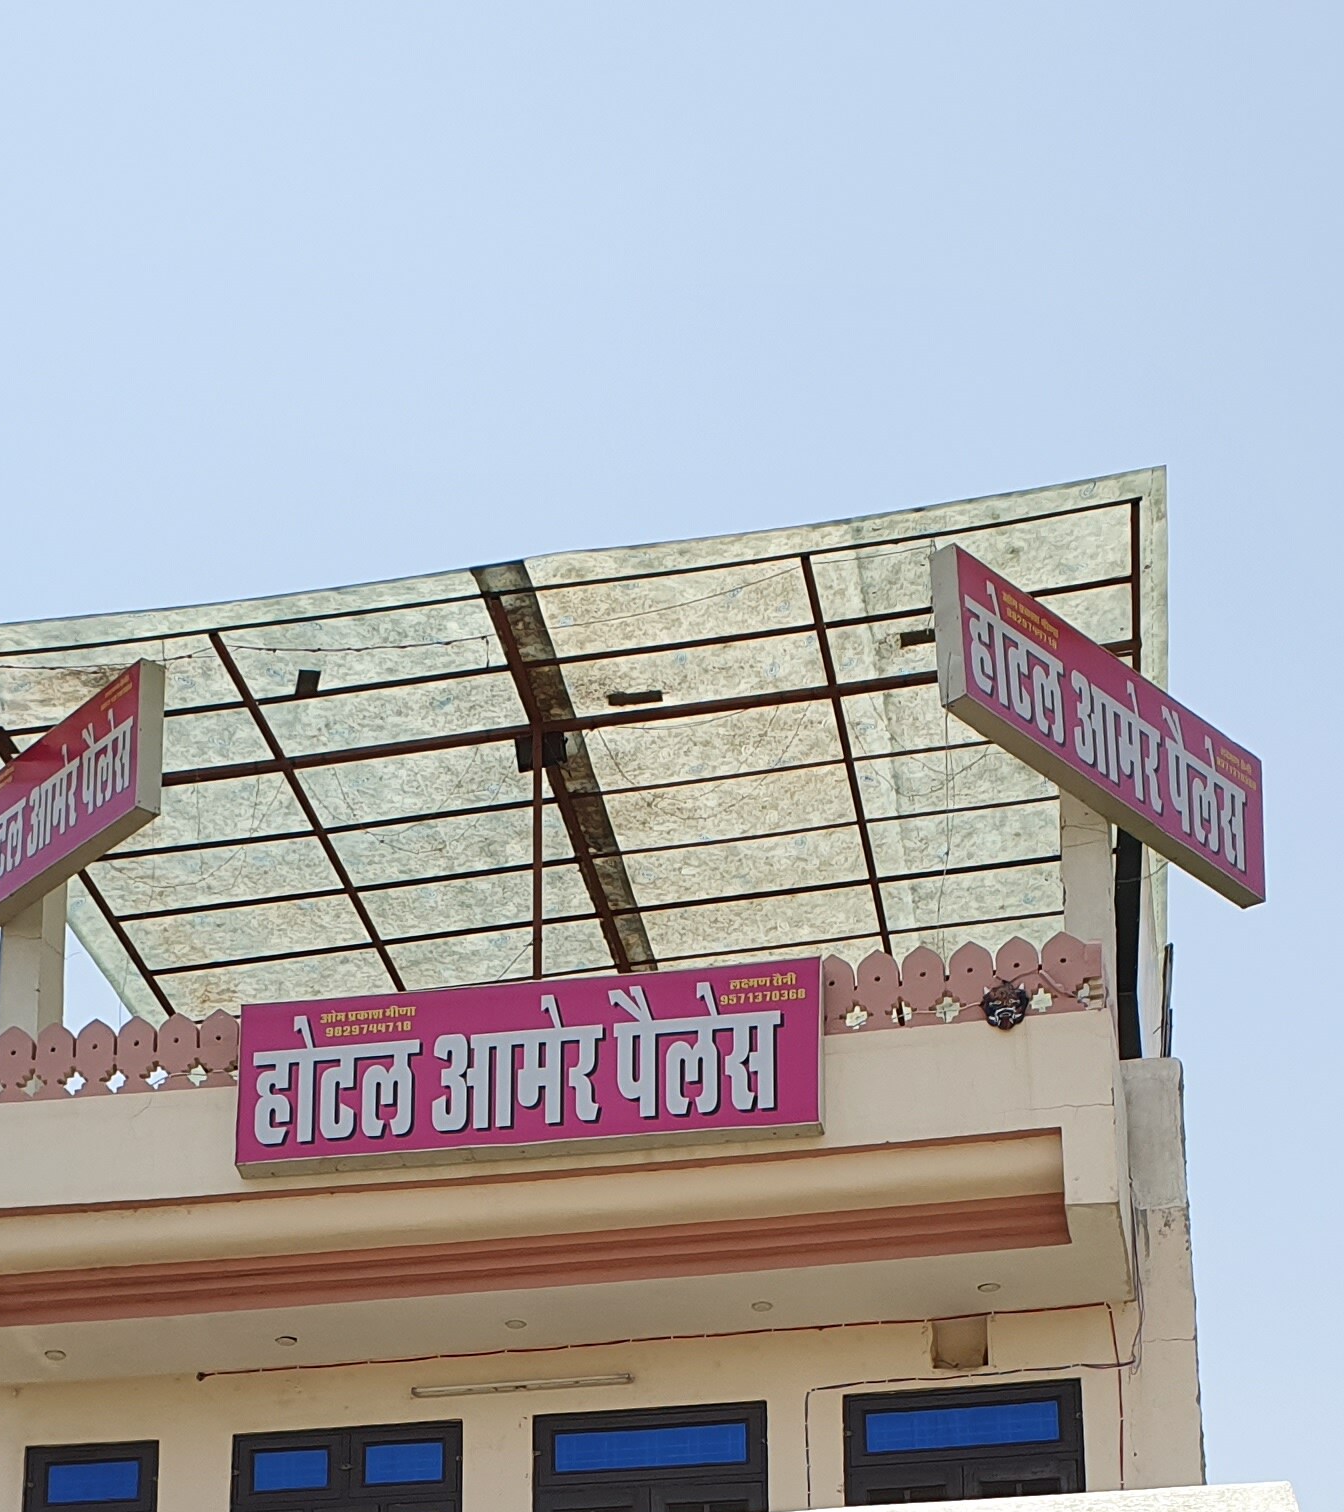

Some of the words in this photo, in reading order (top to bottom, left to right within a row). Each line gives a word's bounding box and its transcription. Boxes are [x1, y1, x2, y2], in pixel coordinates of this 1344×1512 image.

[27, 744, 80, 858] आमेर
[82, 708, 134, 815] पैलेस
[964, 579, 1064, 745] होटल
[1071, 669, 1165, 816] आमेर
[1161, 704, 1247, 873] पैलेस
[253, 1015, 421, 1146] होटल
[432, 994, 603, 1133] आमेर
[609, 982, 781, 1119] पैलेस
